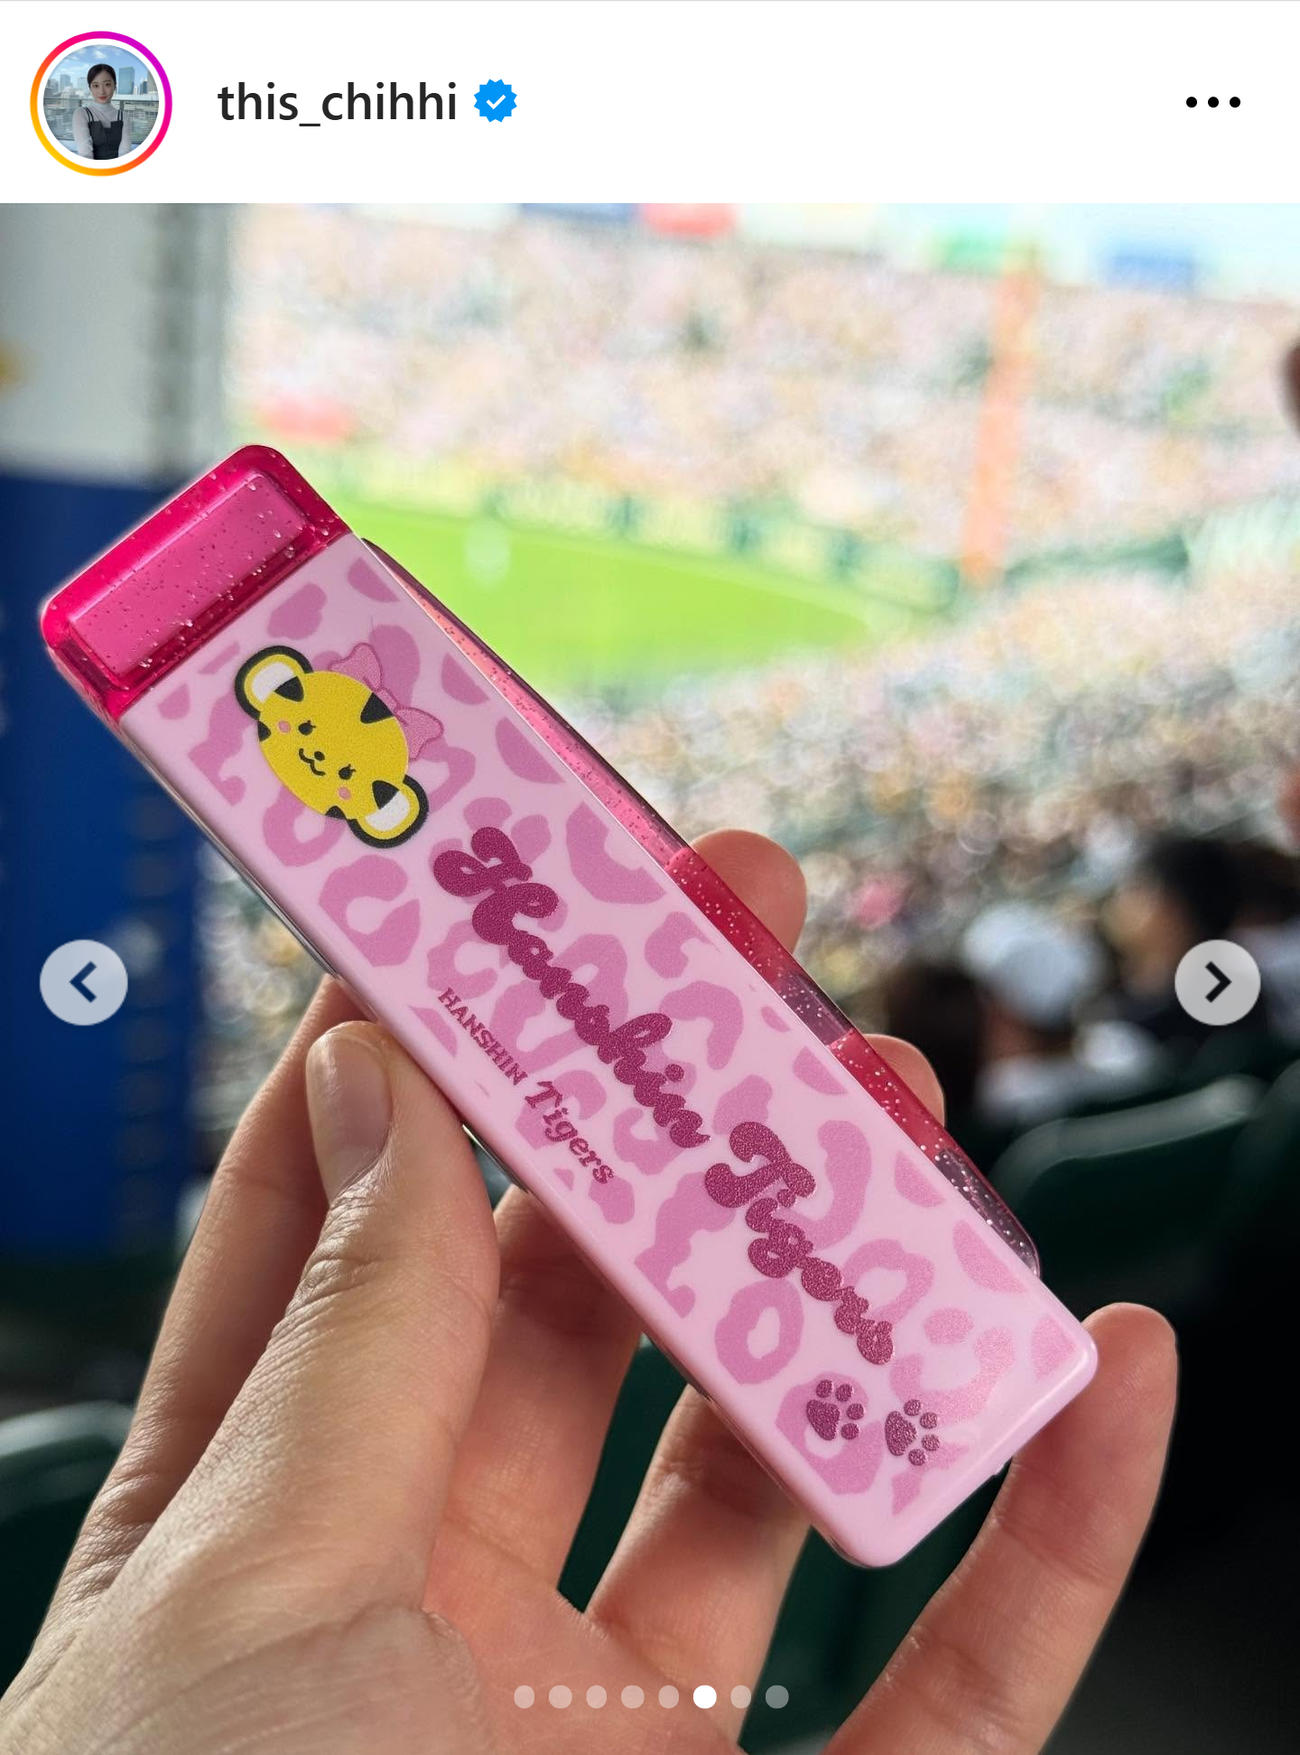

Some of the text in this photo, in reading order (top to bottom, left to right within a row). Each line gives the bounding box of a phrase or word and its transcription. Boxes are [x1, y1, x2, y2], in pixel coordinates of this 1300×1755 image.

[432, 826, 896, 1366] Hanshin Tigers
[436, 987, 617, 1186] HANSHIN Tigers
